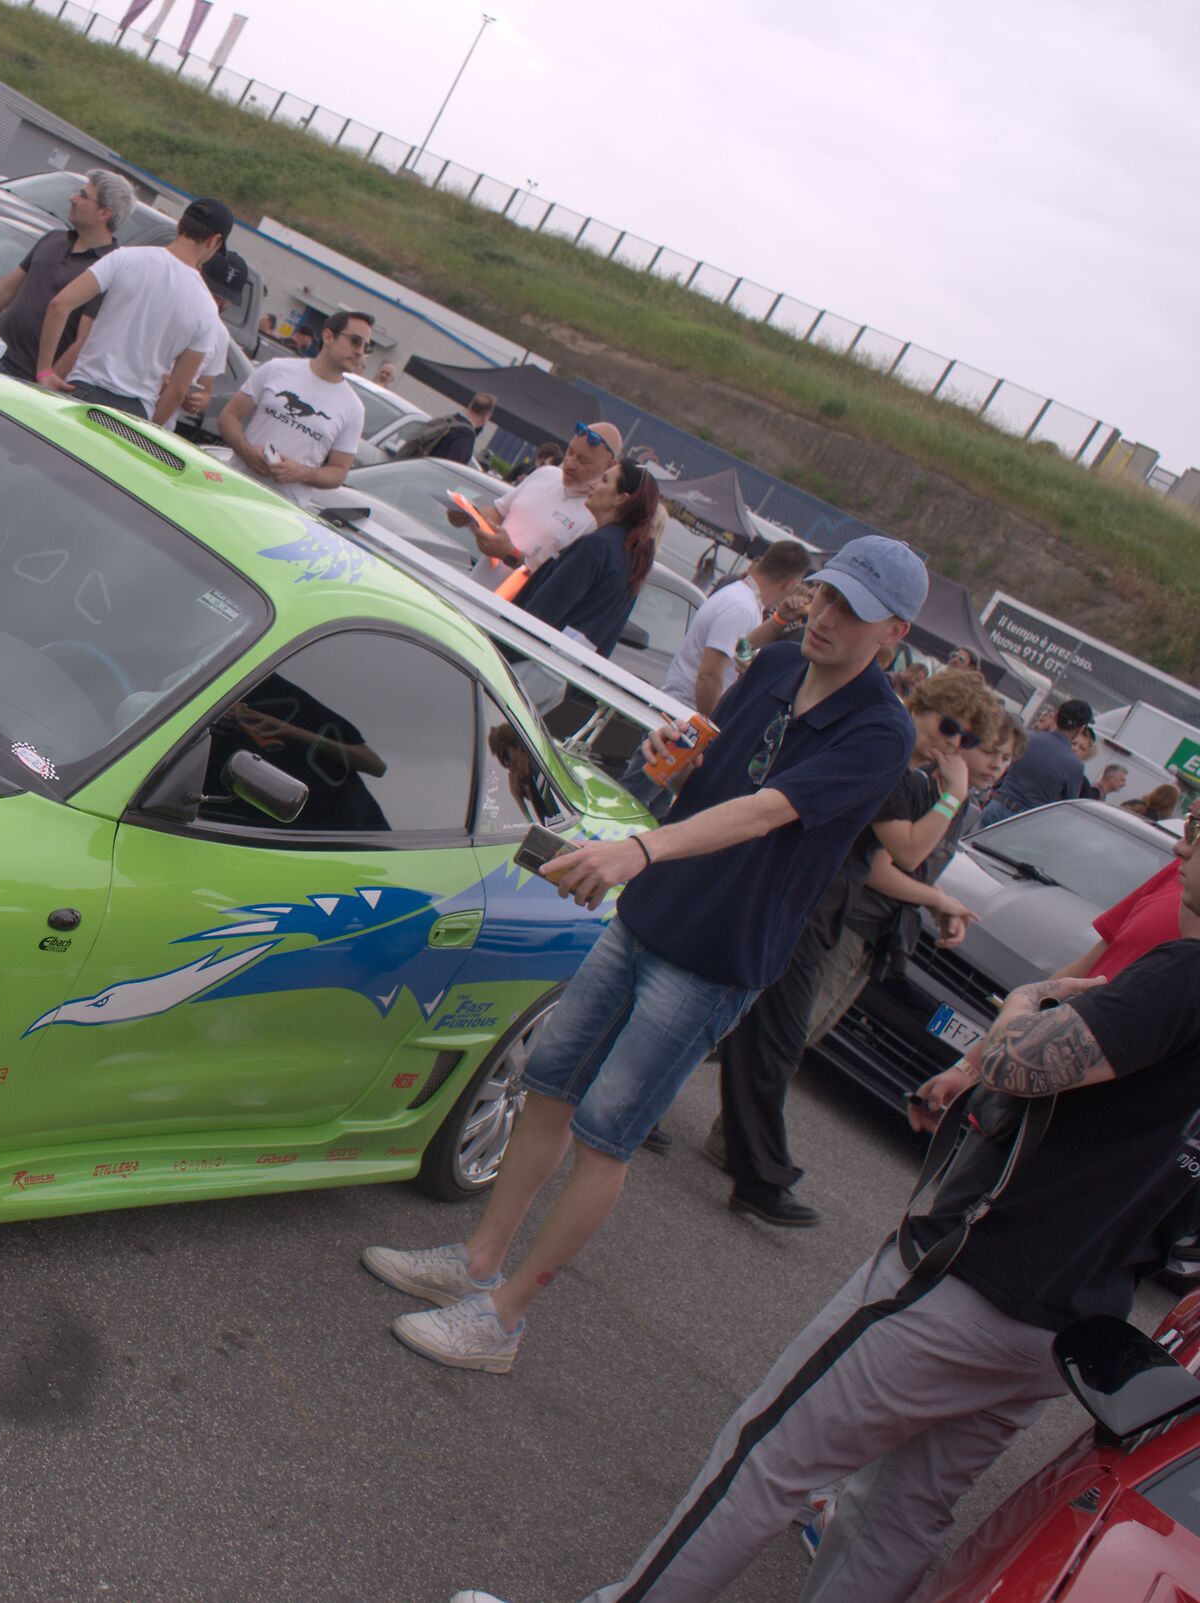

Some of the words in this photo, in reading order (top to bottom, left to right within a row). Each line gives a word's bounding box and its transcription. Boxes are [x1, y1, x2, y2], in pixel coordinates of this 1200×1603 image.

[265, 407, 323, 441] MUSTANG
[990, 630, 1022, 654] Nuova
[1022, 646, 1045, 665] 911
[1006, 621, 1040, 645] tempo
[1045, 642, 1093, 671] prezoso.
[432, 1013, 498, 1031] FURIOUS
[455, 1000, 494, 1013] FAST
